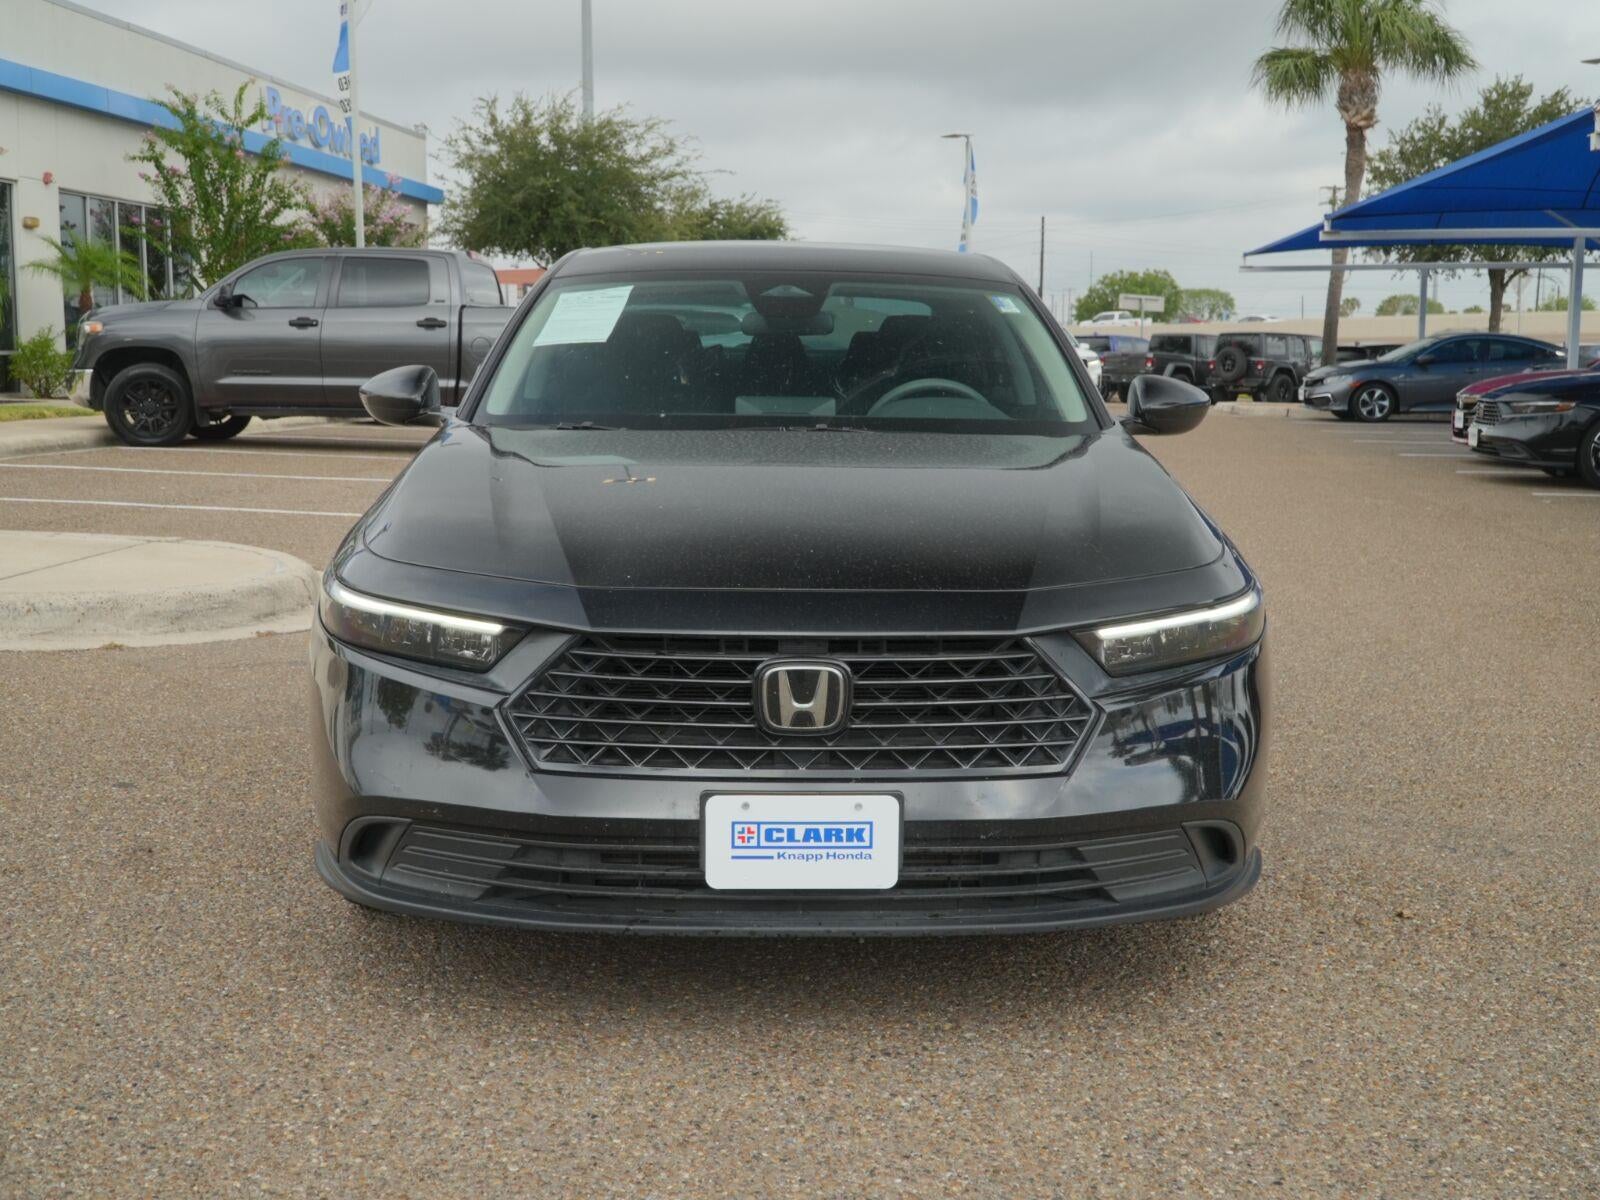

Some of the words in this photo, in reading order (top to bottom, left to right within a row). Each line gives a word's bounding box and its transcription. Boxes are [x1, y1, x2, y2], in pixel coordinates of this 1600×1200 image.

[265, 86, 382, 166] Pre-Owed
[764, 827, 866, 843] CLARK
[776, 851, 824, 862] Knapp
[826, 851, 873, 861] Honda
